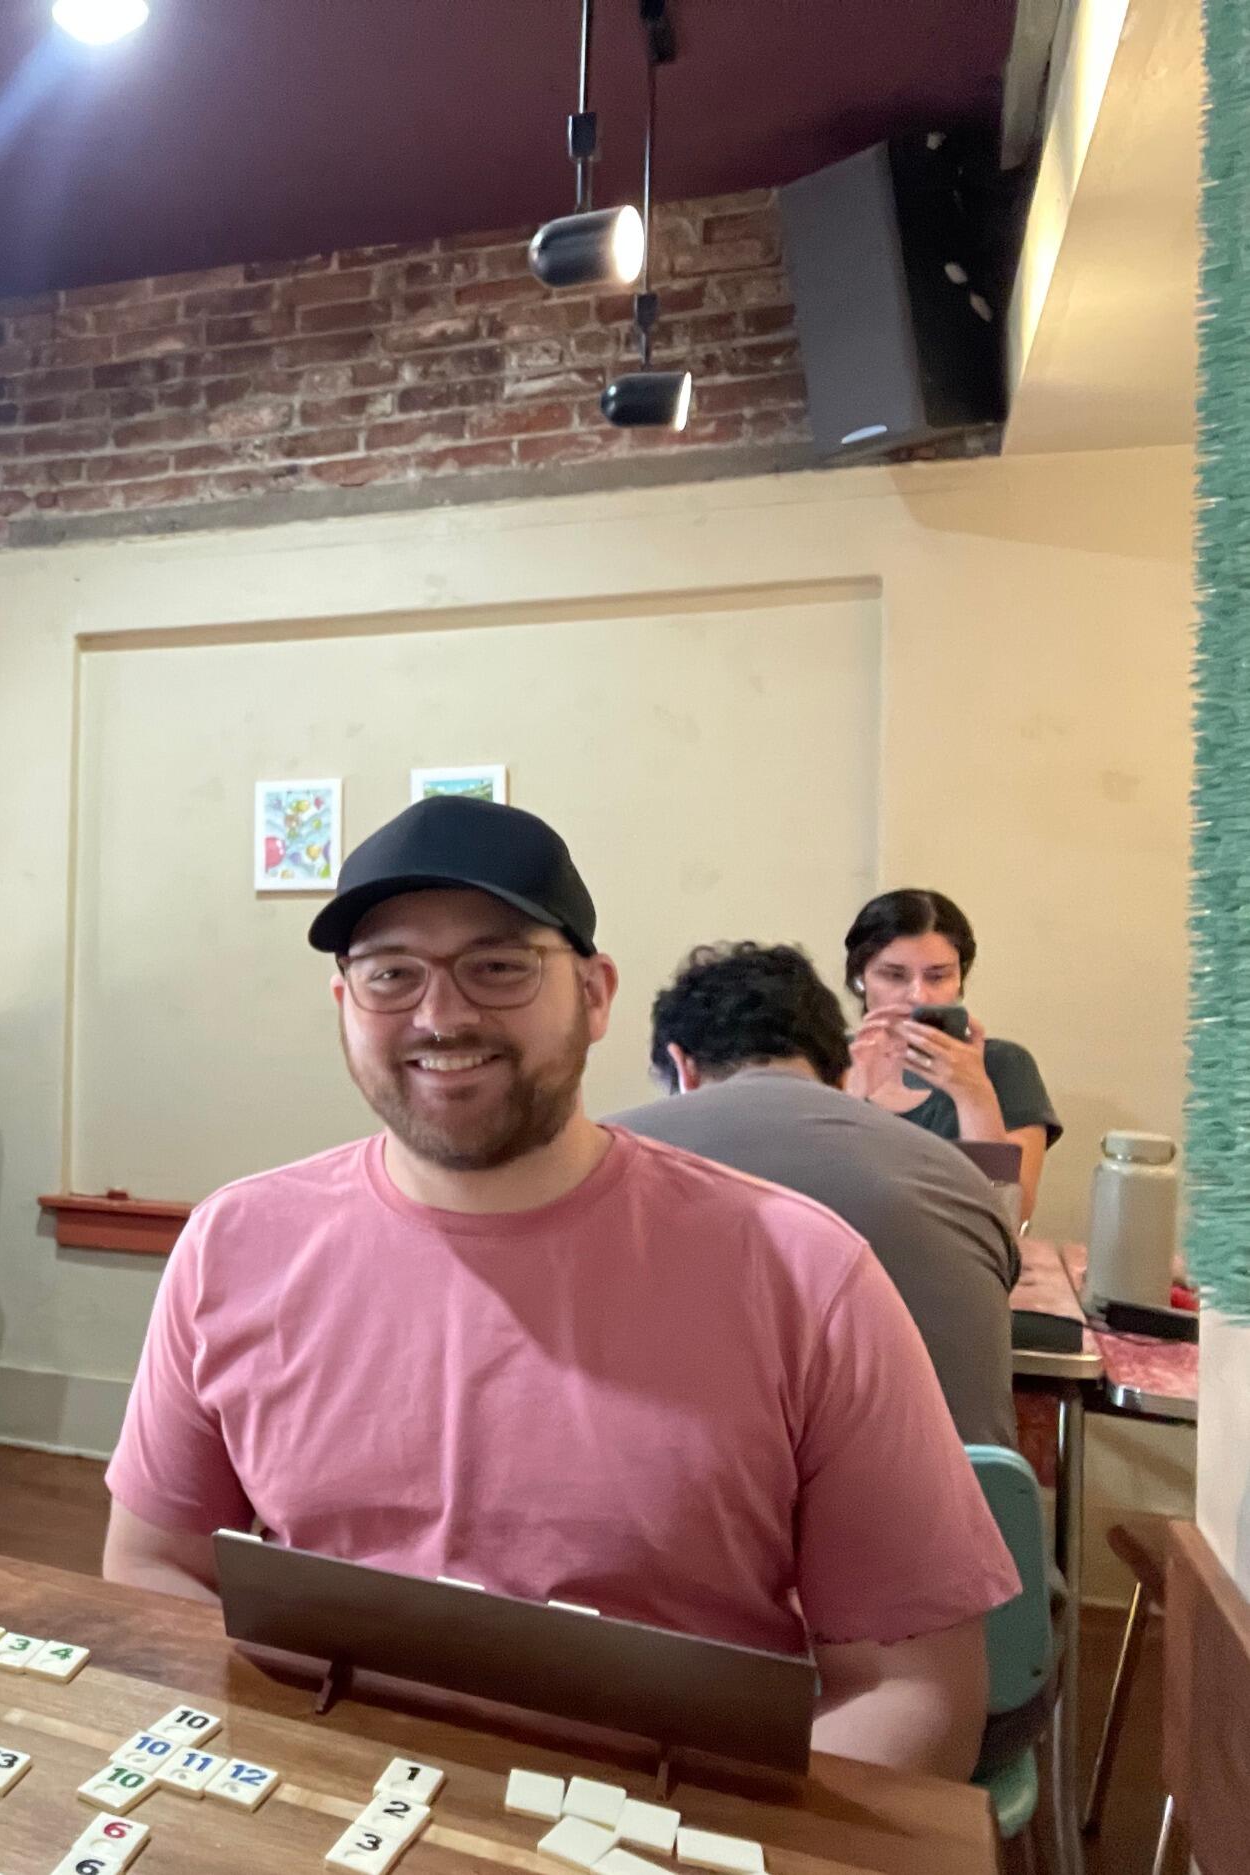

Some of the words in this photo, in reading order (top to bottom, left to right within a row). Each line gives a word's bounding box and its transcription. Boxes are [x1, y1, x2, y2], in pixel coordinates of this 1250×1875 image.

[9, 1638, 32, 1651] 3
[50, 1647, 73, 1661] 4
[176, 1710, 210, 1730] 10
[135, 1736, 171, 1756] 10
[182, 1753, 214, 1773] 11
[230, 1765, 267, 1786] 12
[108, 1767, 145, 1789] 10
[406, 1767, 421, 1781] 1
[383, 1800, 411, 1819] 2
[103, 1822, 133, 1839] 6
[356, 1833, 382, 1851] 3
[75, 1859, 106, 1875] 6
